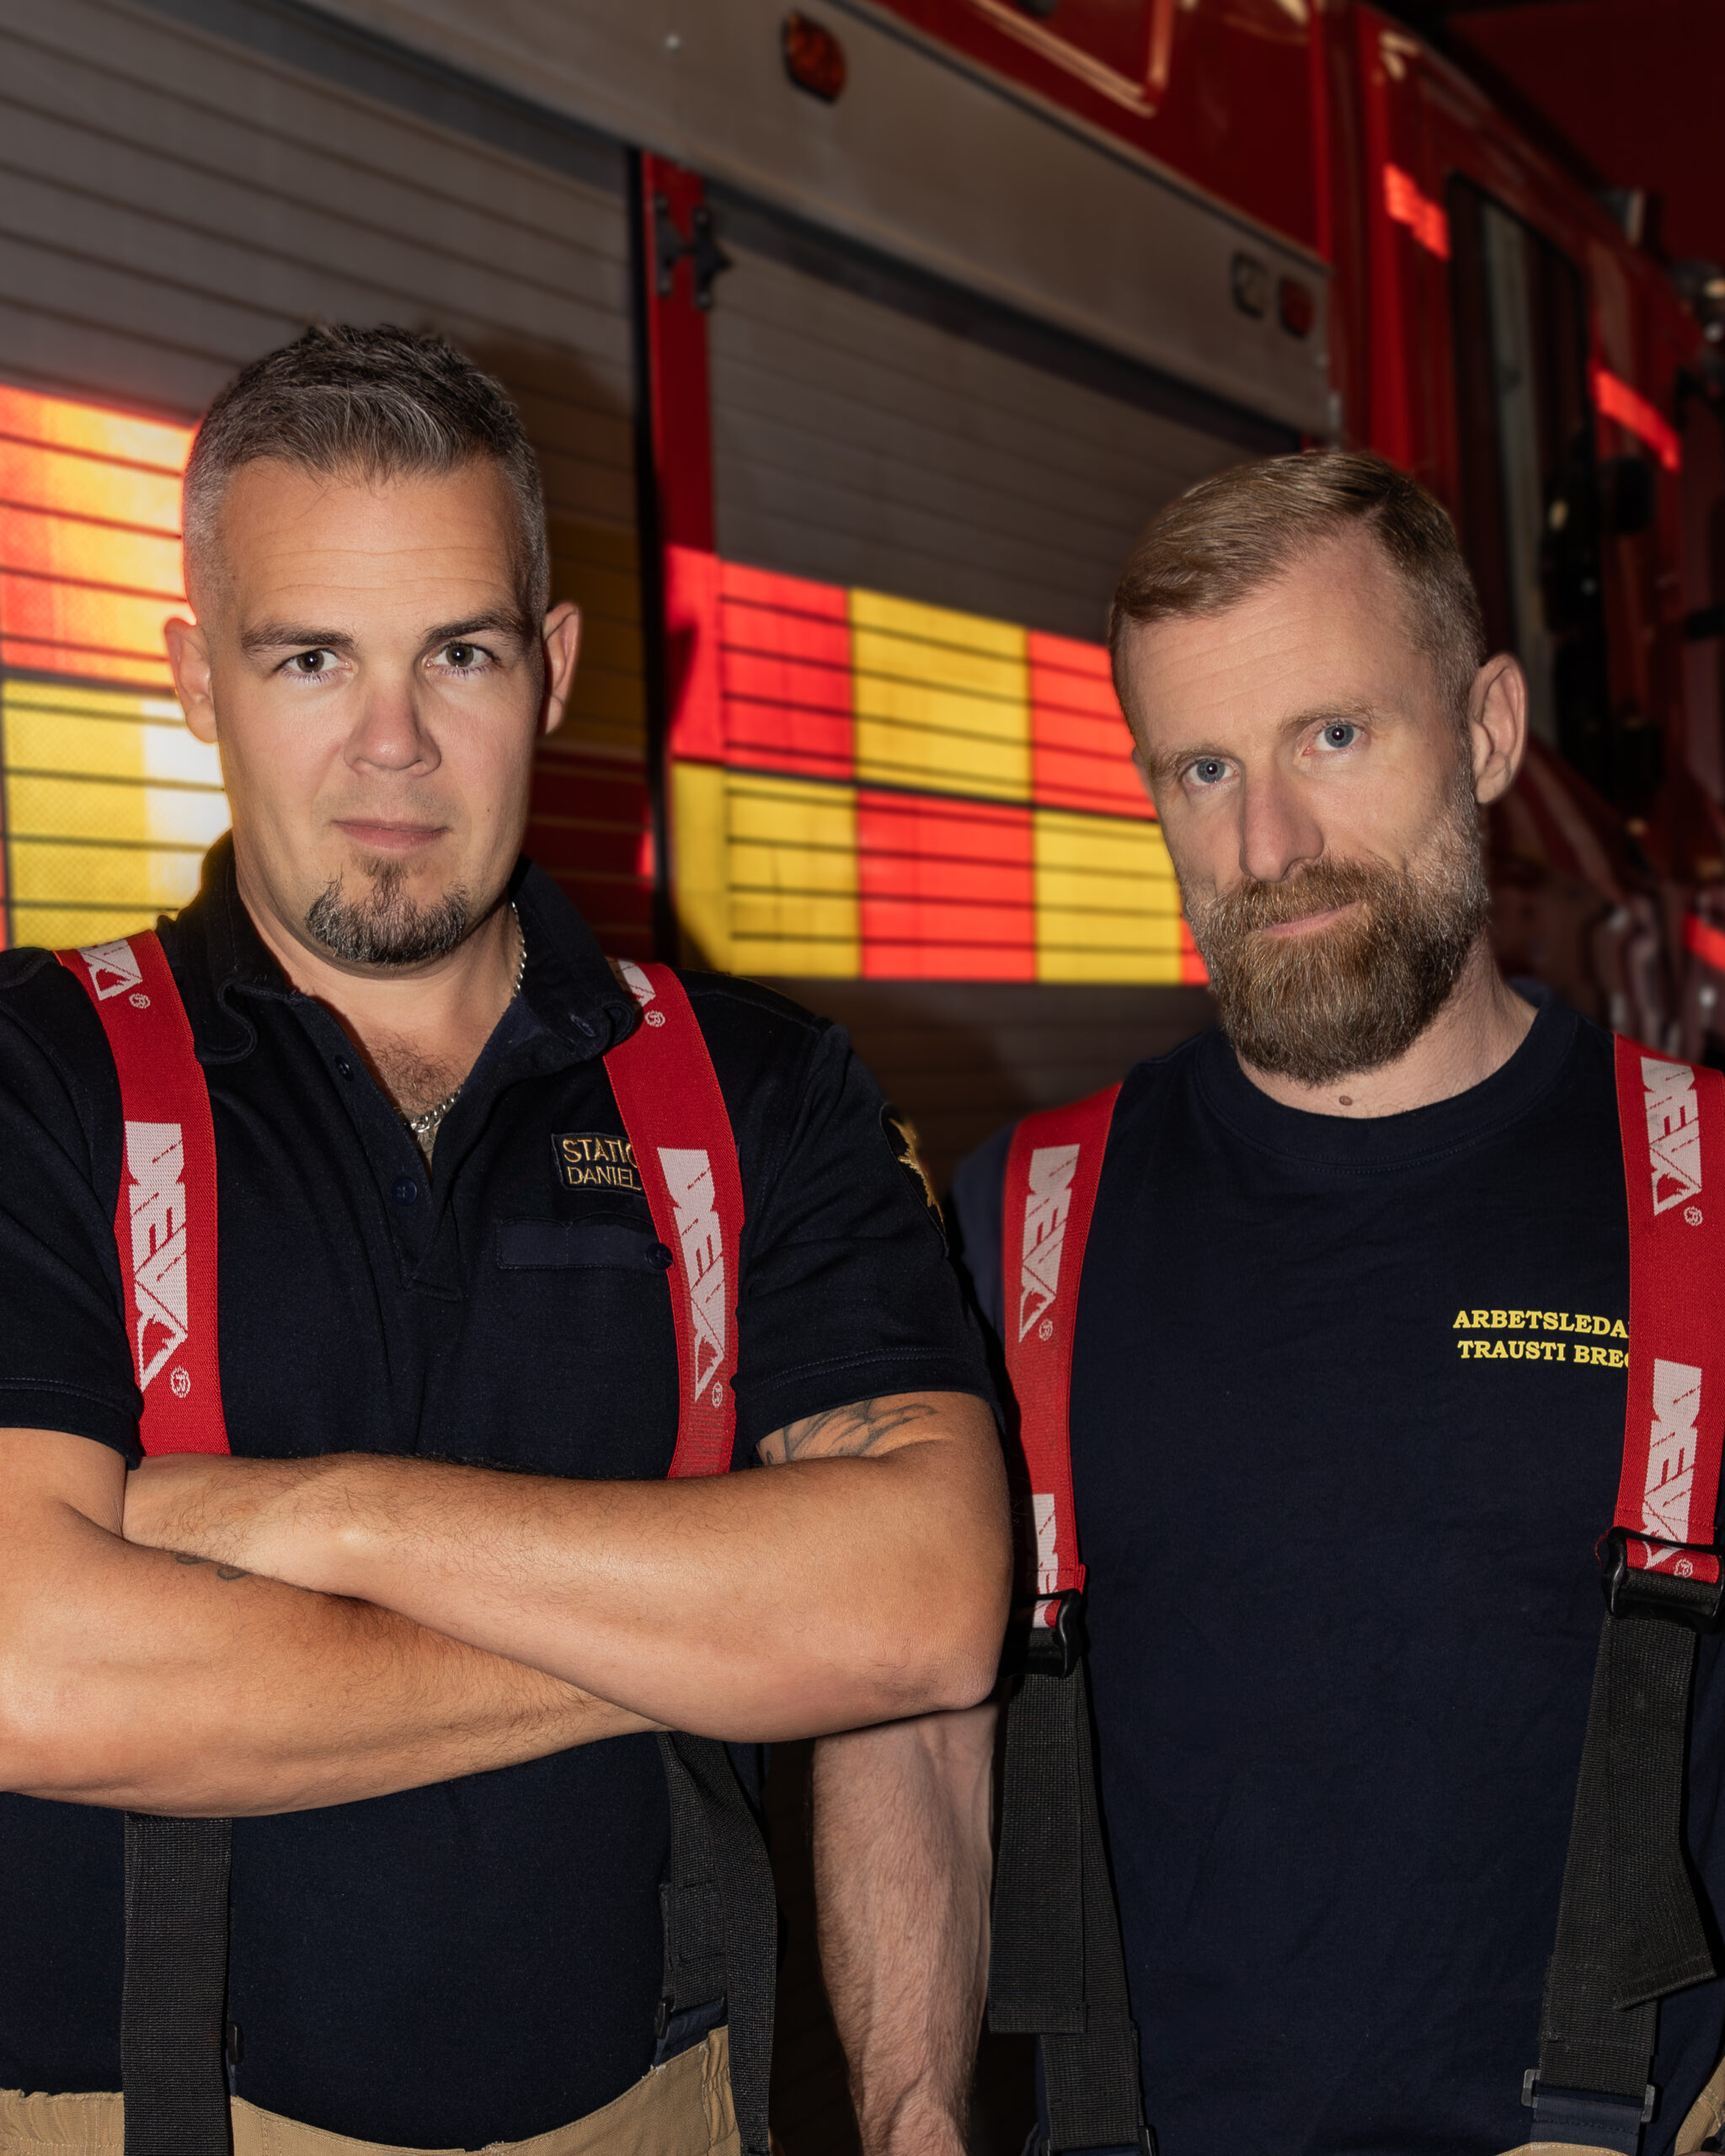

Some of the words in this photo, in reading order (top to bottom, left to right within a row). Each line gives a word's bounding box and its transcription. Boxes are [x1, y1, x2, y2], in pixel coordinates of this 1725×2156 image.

[1453, 1310, 1630, 1339] ARBETSLEDA
[1457, 1341, 1567, 1362] TRAUSTI
[1573, 1345, 1630, 1369] BRE
